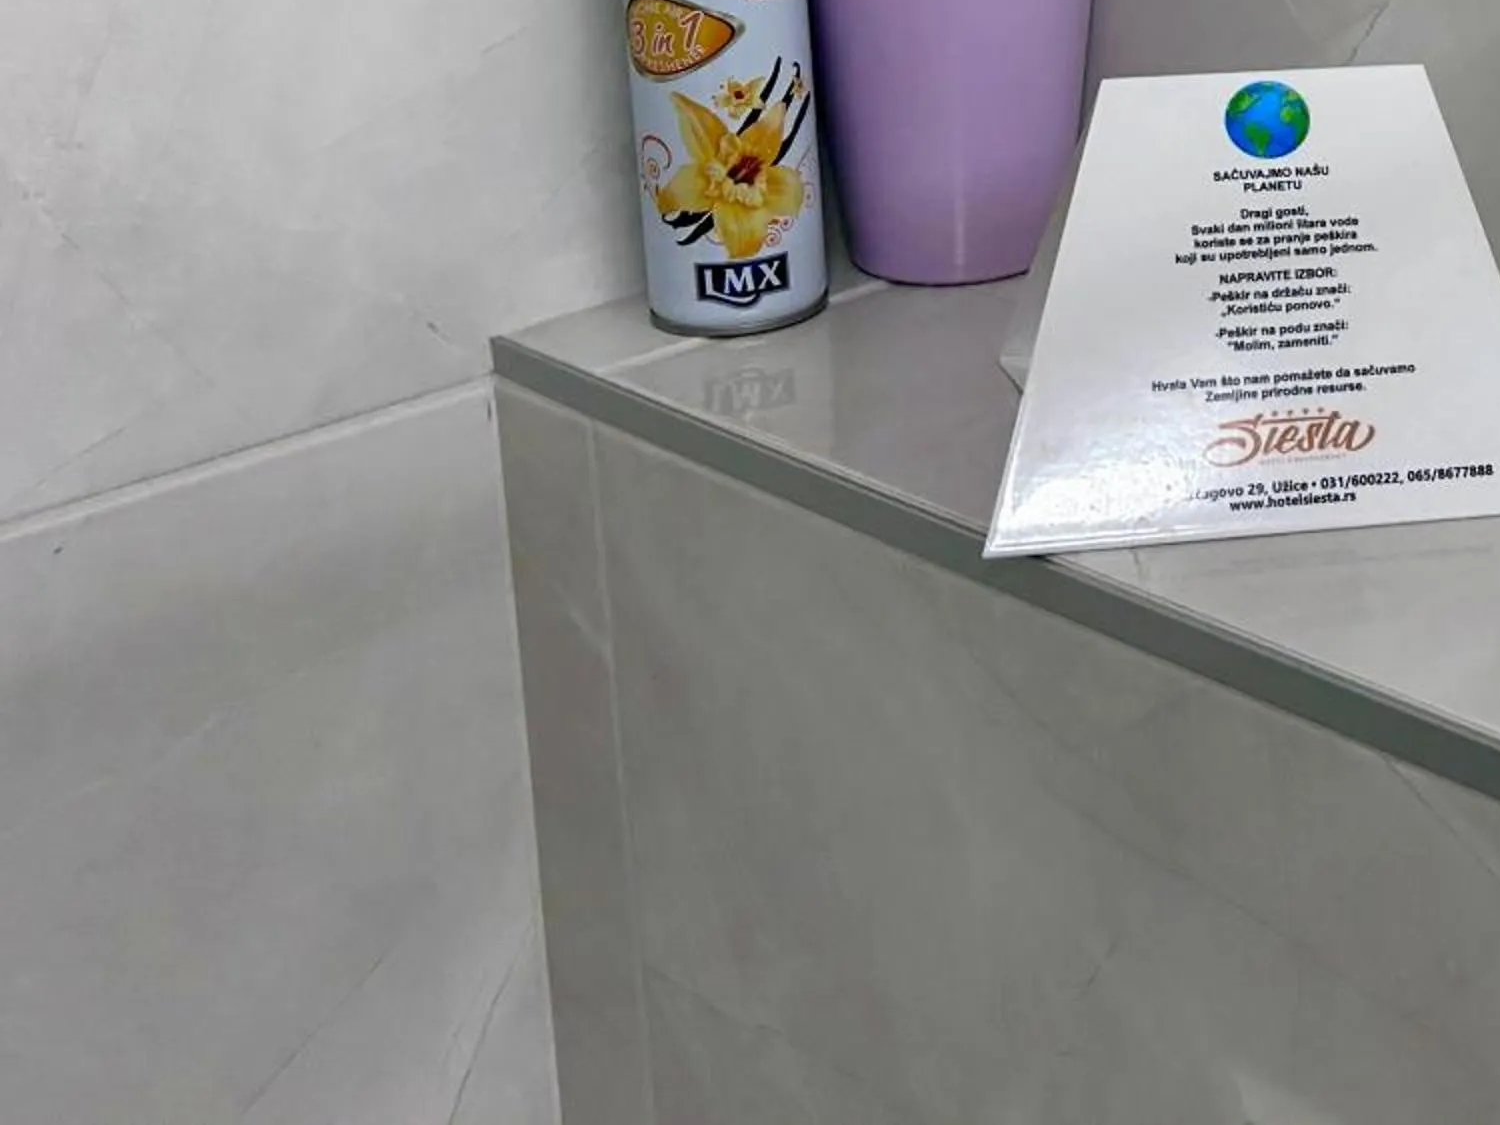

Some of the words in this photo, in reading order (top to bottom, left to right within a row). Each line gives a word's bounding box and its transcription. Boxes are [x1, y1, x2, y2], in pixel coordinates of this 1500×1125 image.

[630, 18, 647, 57] 3
[650, 22, 676, 57] in
[680, 10, 705, 52] 1
[1213, 166, 1292, 182] SAČUVAJMO
[1295, 163, 1329, 177] NAŠU
[1243, 180, 1303, 193] PLANETU
[1240, 207, 1273, 220] Dragi
[1275, 205, 1309, 220] gosti,
[1191, 224, 1225, 236] Svaki
[1227, 222, 1251, 234] dan
[1253, 219, 1293, 232] milioni
[1239, 236, 1253, 246] se
[1255, 235, 1271, 246] za
[1175, 252, 1198, 265] koji
[1201, 253, 1217, 263] su
[1293, 246, 1327, 256] samo
[703, 260, 783, 303] LMX
[1219, 269, 1293, 284] NAPRAVITE
[1253, 289, 1269, 300] na
[1261, 325, 1276, 336] na
[1279, 322, 1311, 337] podu
[1151, 379, 1187, 392] Hvala
[1189, 378, 1217, 389] Vam
[1243, 374, 1271, 385] nam
[1335, 366, 1351, 378] da
[1205, 389, 1259, 403] Zemljine
[1202, 411, 1376, 468] Siesta
[1247, 482, 1269, 496] 29,
[1271, 480, 1309, 494] Užice
[1320, 472, 1404, 489] 031/600222,
[1407, 463, 1494, 482] 065/8677888
[1229, 492, 1357, 511] www.hotelsiesta.rs
